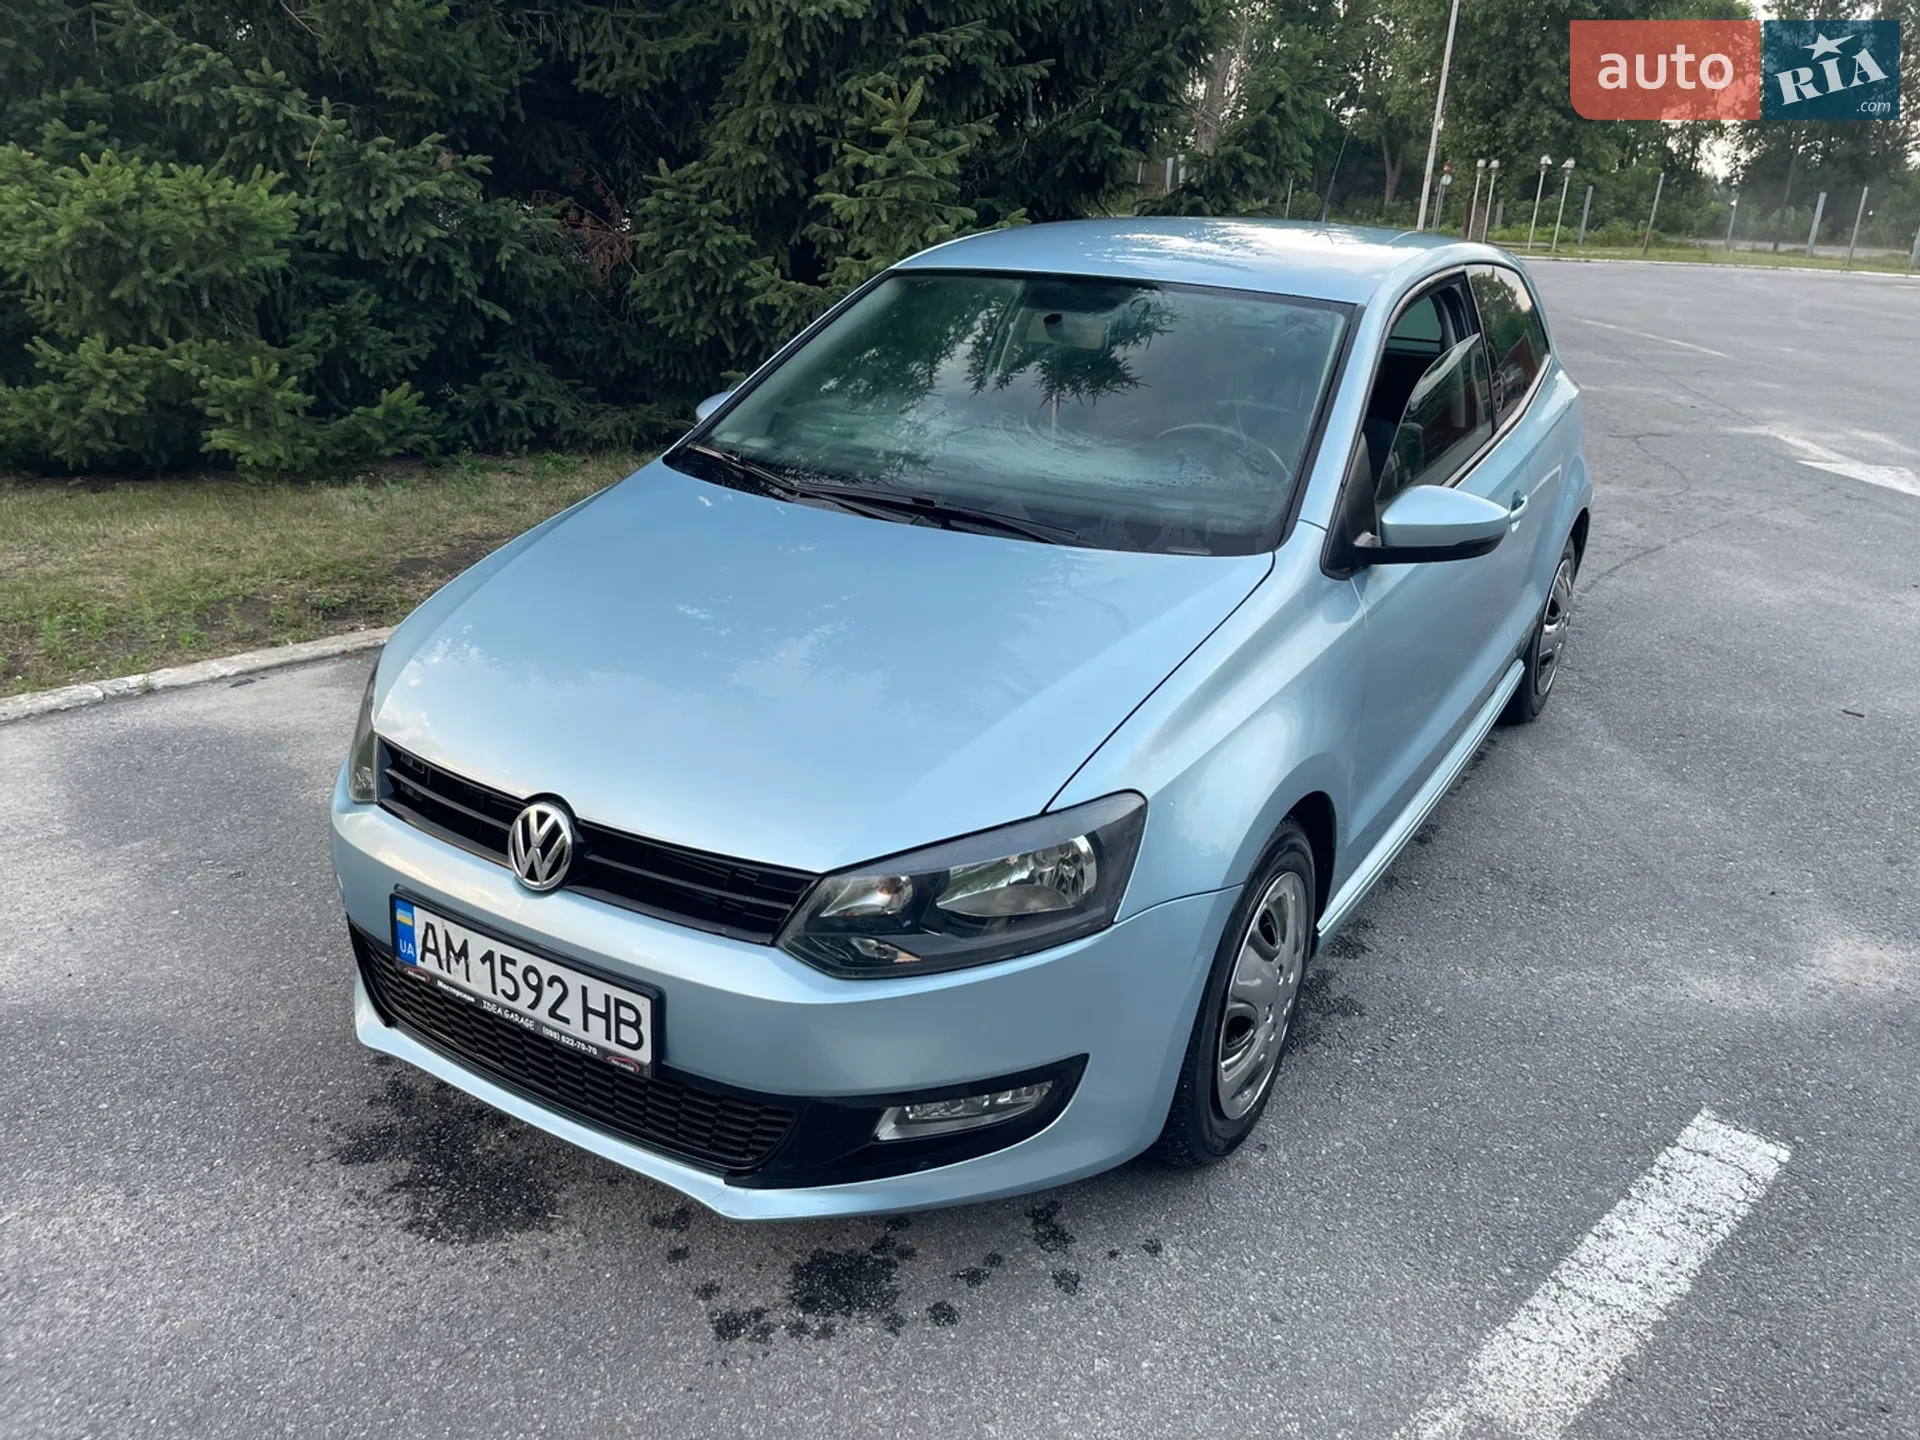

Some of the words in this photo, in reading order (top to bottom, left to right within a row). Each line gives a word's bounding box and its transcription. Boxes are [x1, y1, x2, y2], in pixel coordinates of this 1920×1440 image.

[399, 938, 415, 957] UA
[420, 921, 471, 983] AM
[480, 949, 571, 1025] 1592
[581, 983, 645, 1051] HB
[482, 1000, 503, 1016] IDEA
[503, 1009, 535, 1031] GARAGE
